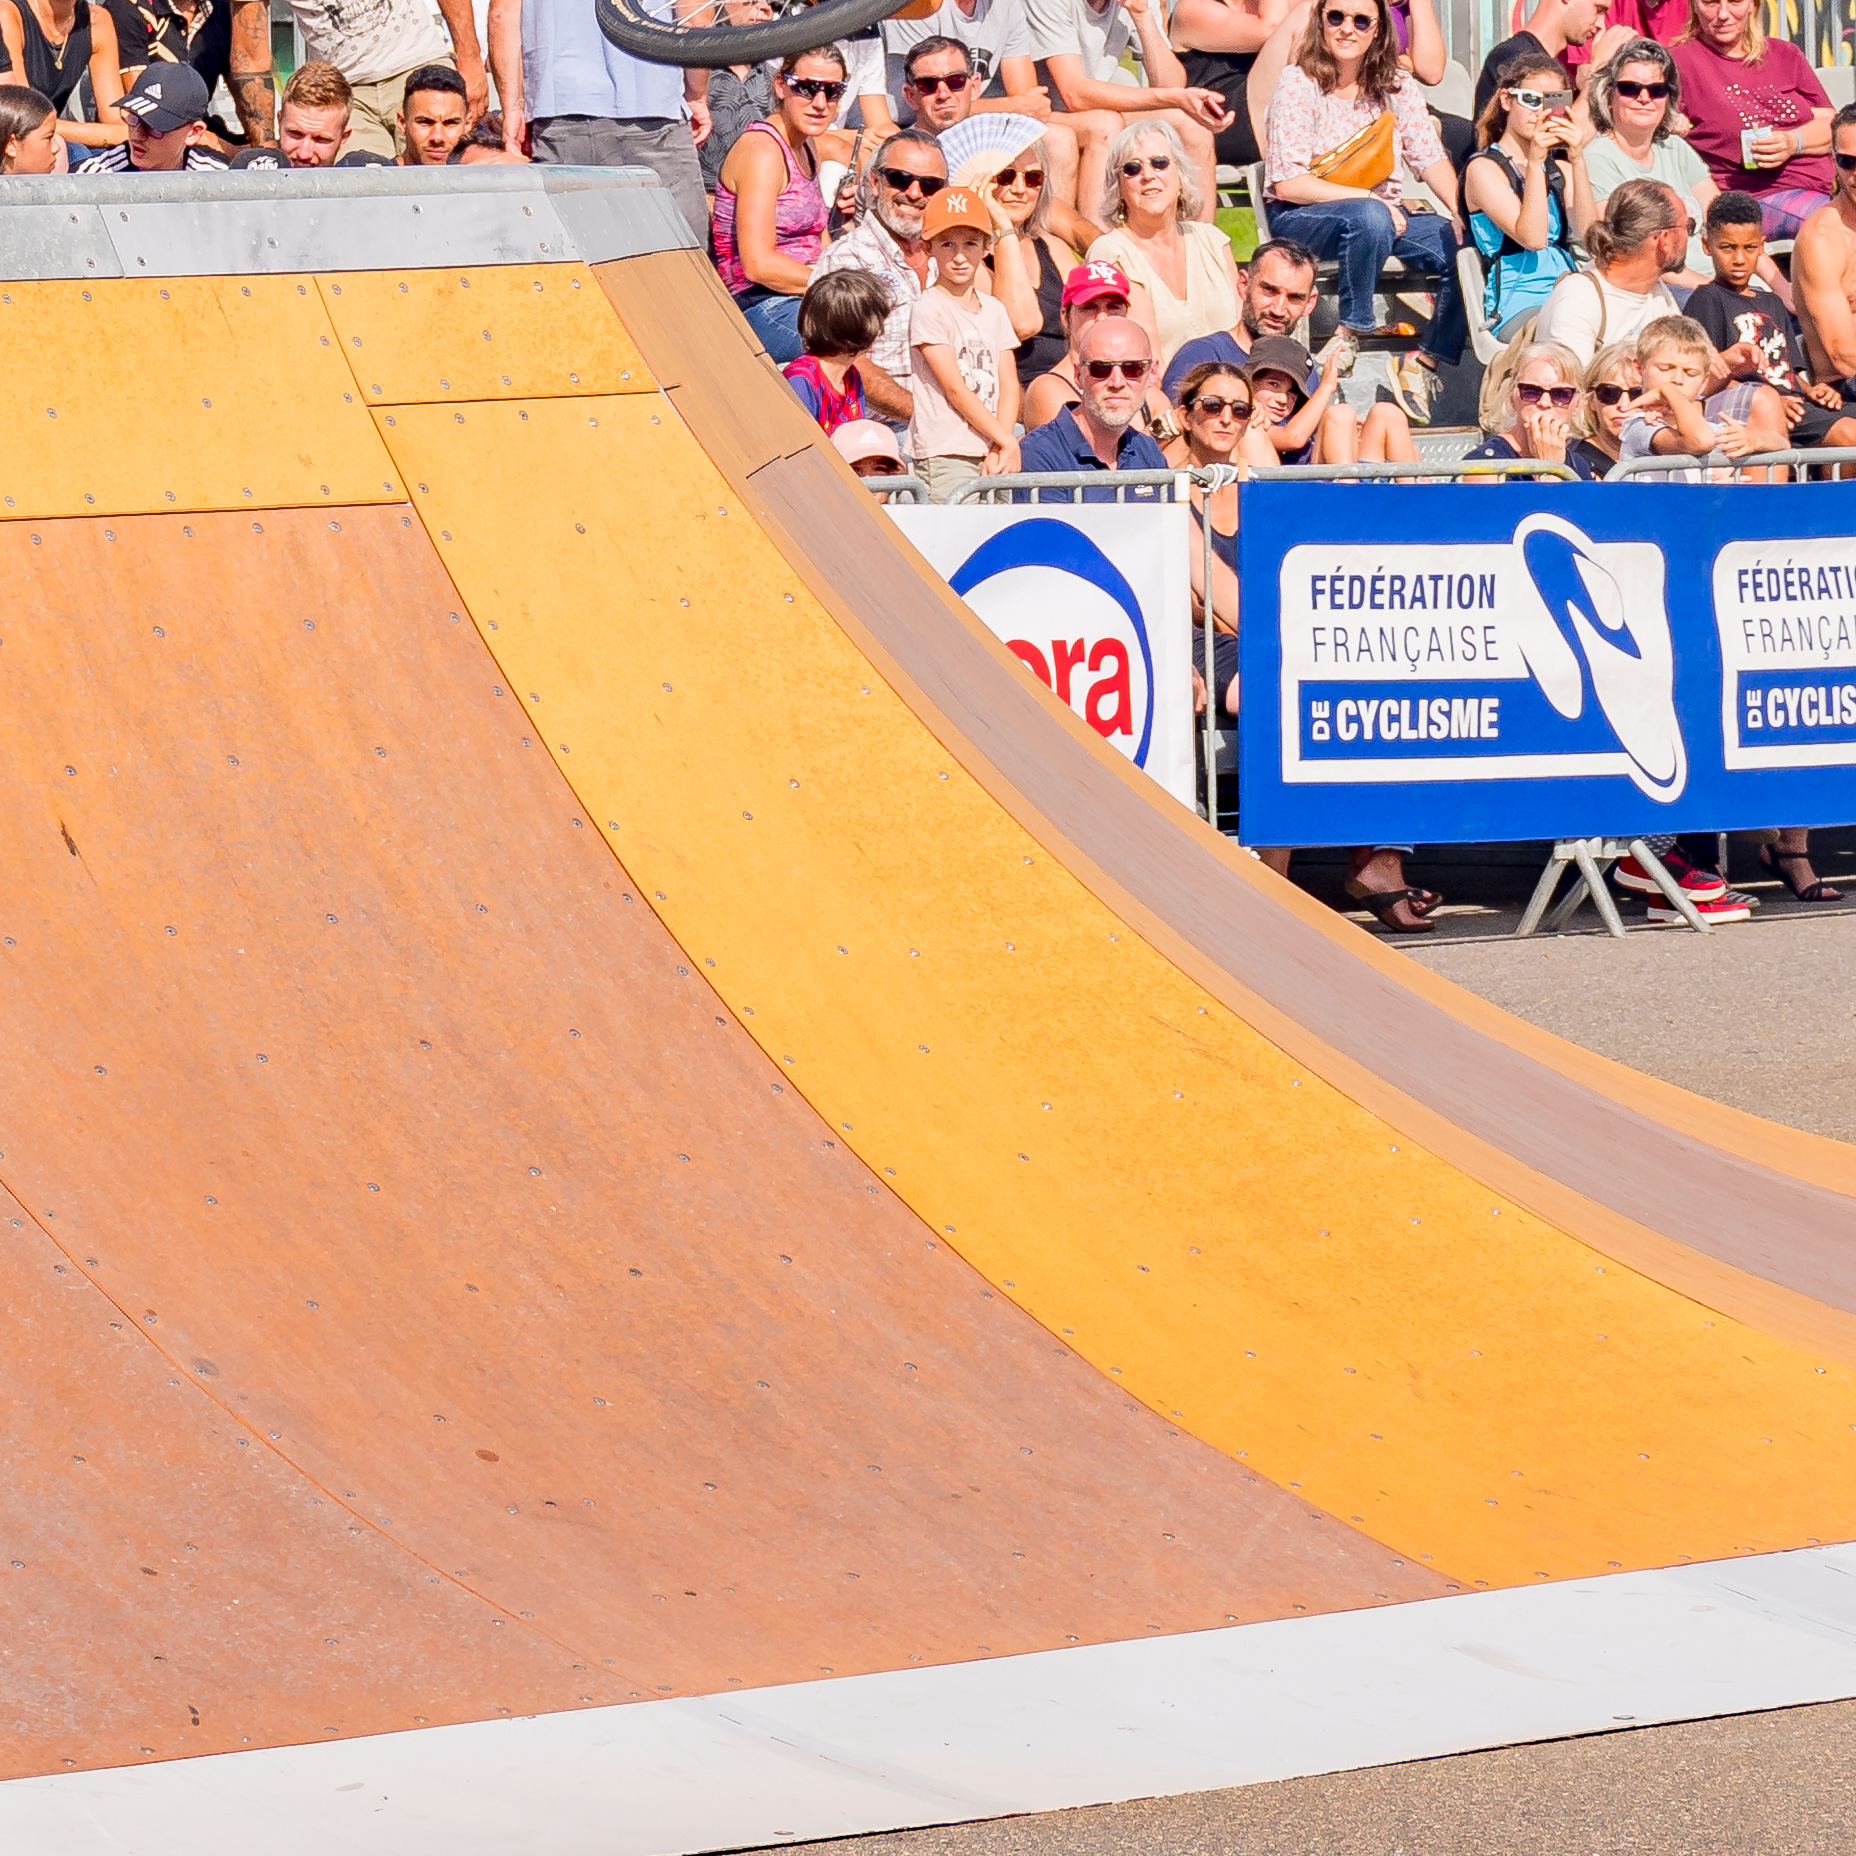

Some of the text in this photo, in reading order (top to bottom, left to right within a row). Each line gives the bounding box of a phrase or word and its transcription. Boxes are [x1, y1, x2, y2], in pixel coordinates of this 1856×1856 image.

[1310, 565, 1497, 611] FÉDÉRATION
[1312, 624, 1499, 674] FRANÇAISE
[1311, 697, 1499, 742] DE CYCLISME
[1746, 689, 1763, 728] DE
